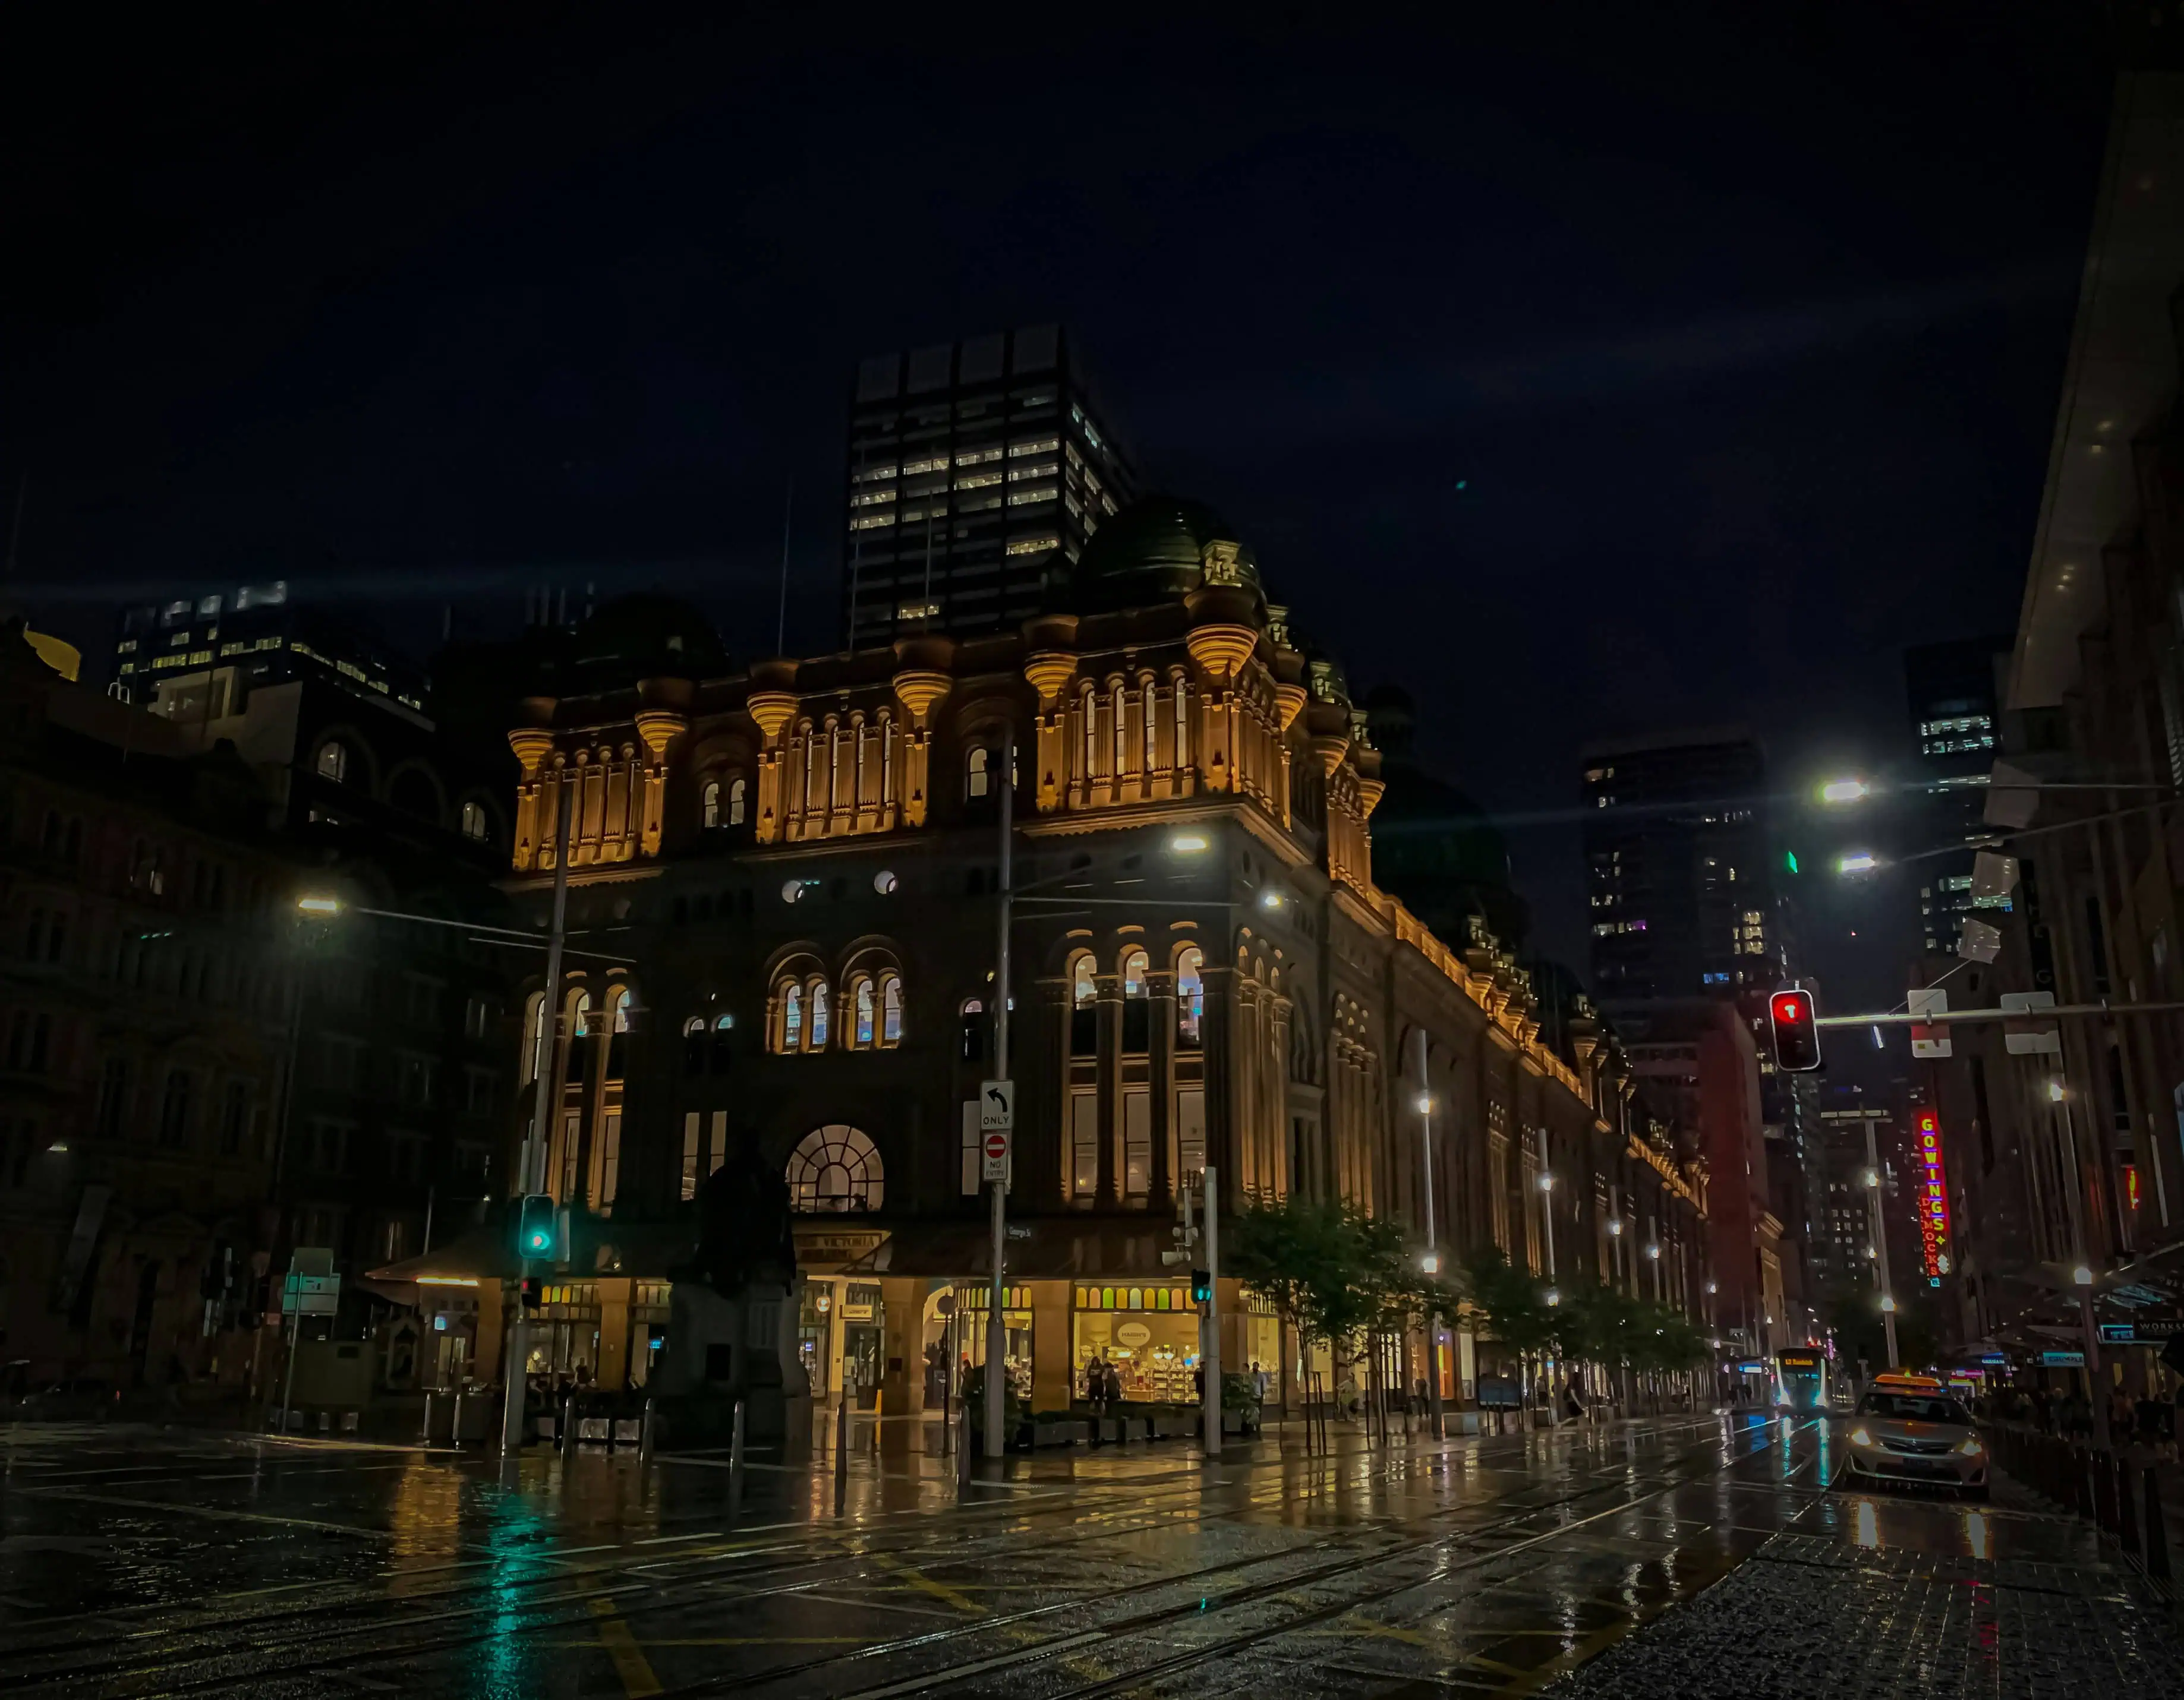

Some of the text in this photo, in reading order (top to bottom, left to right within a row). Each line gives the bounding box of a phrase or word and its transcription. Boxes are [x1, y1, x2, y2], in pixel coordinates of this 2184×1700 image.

[983, 1116, 1009, 1125] ONLY
[1921, 1119, 1945, 1231] GOWINGS
[1921, 1197, 1938, 1275] DYMOCKS
